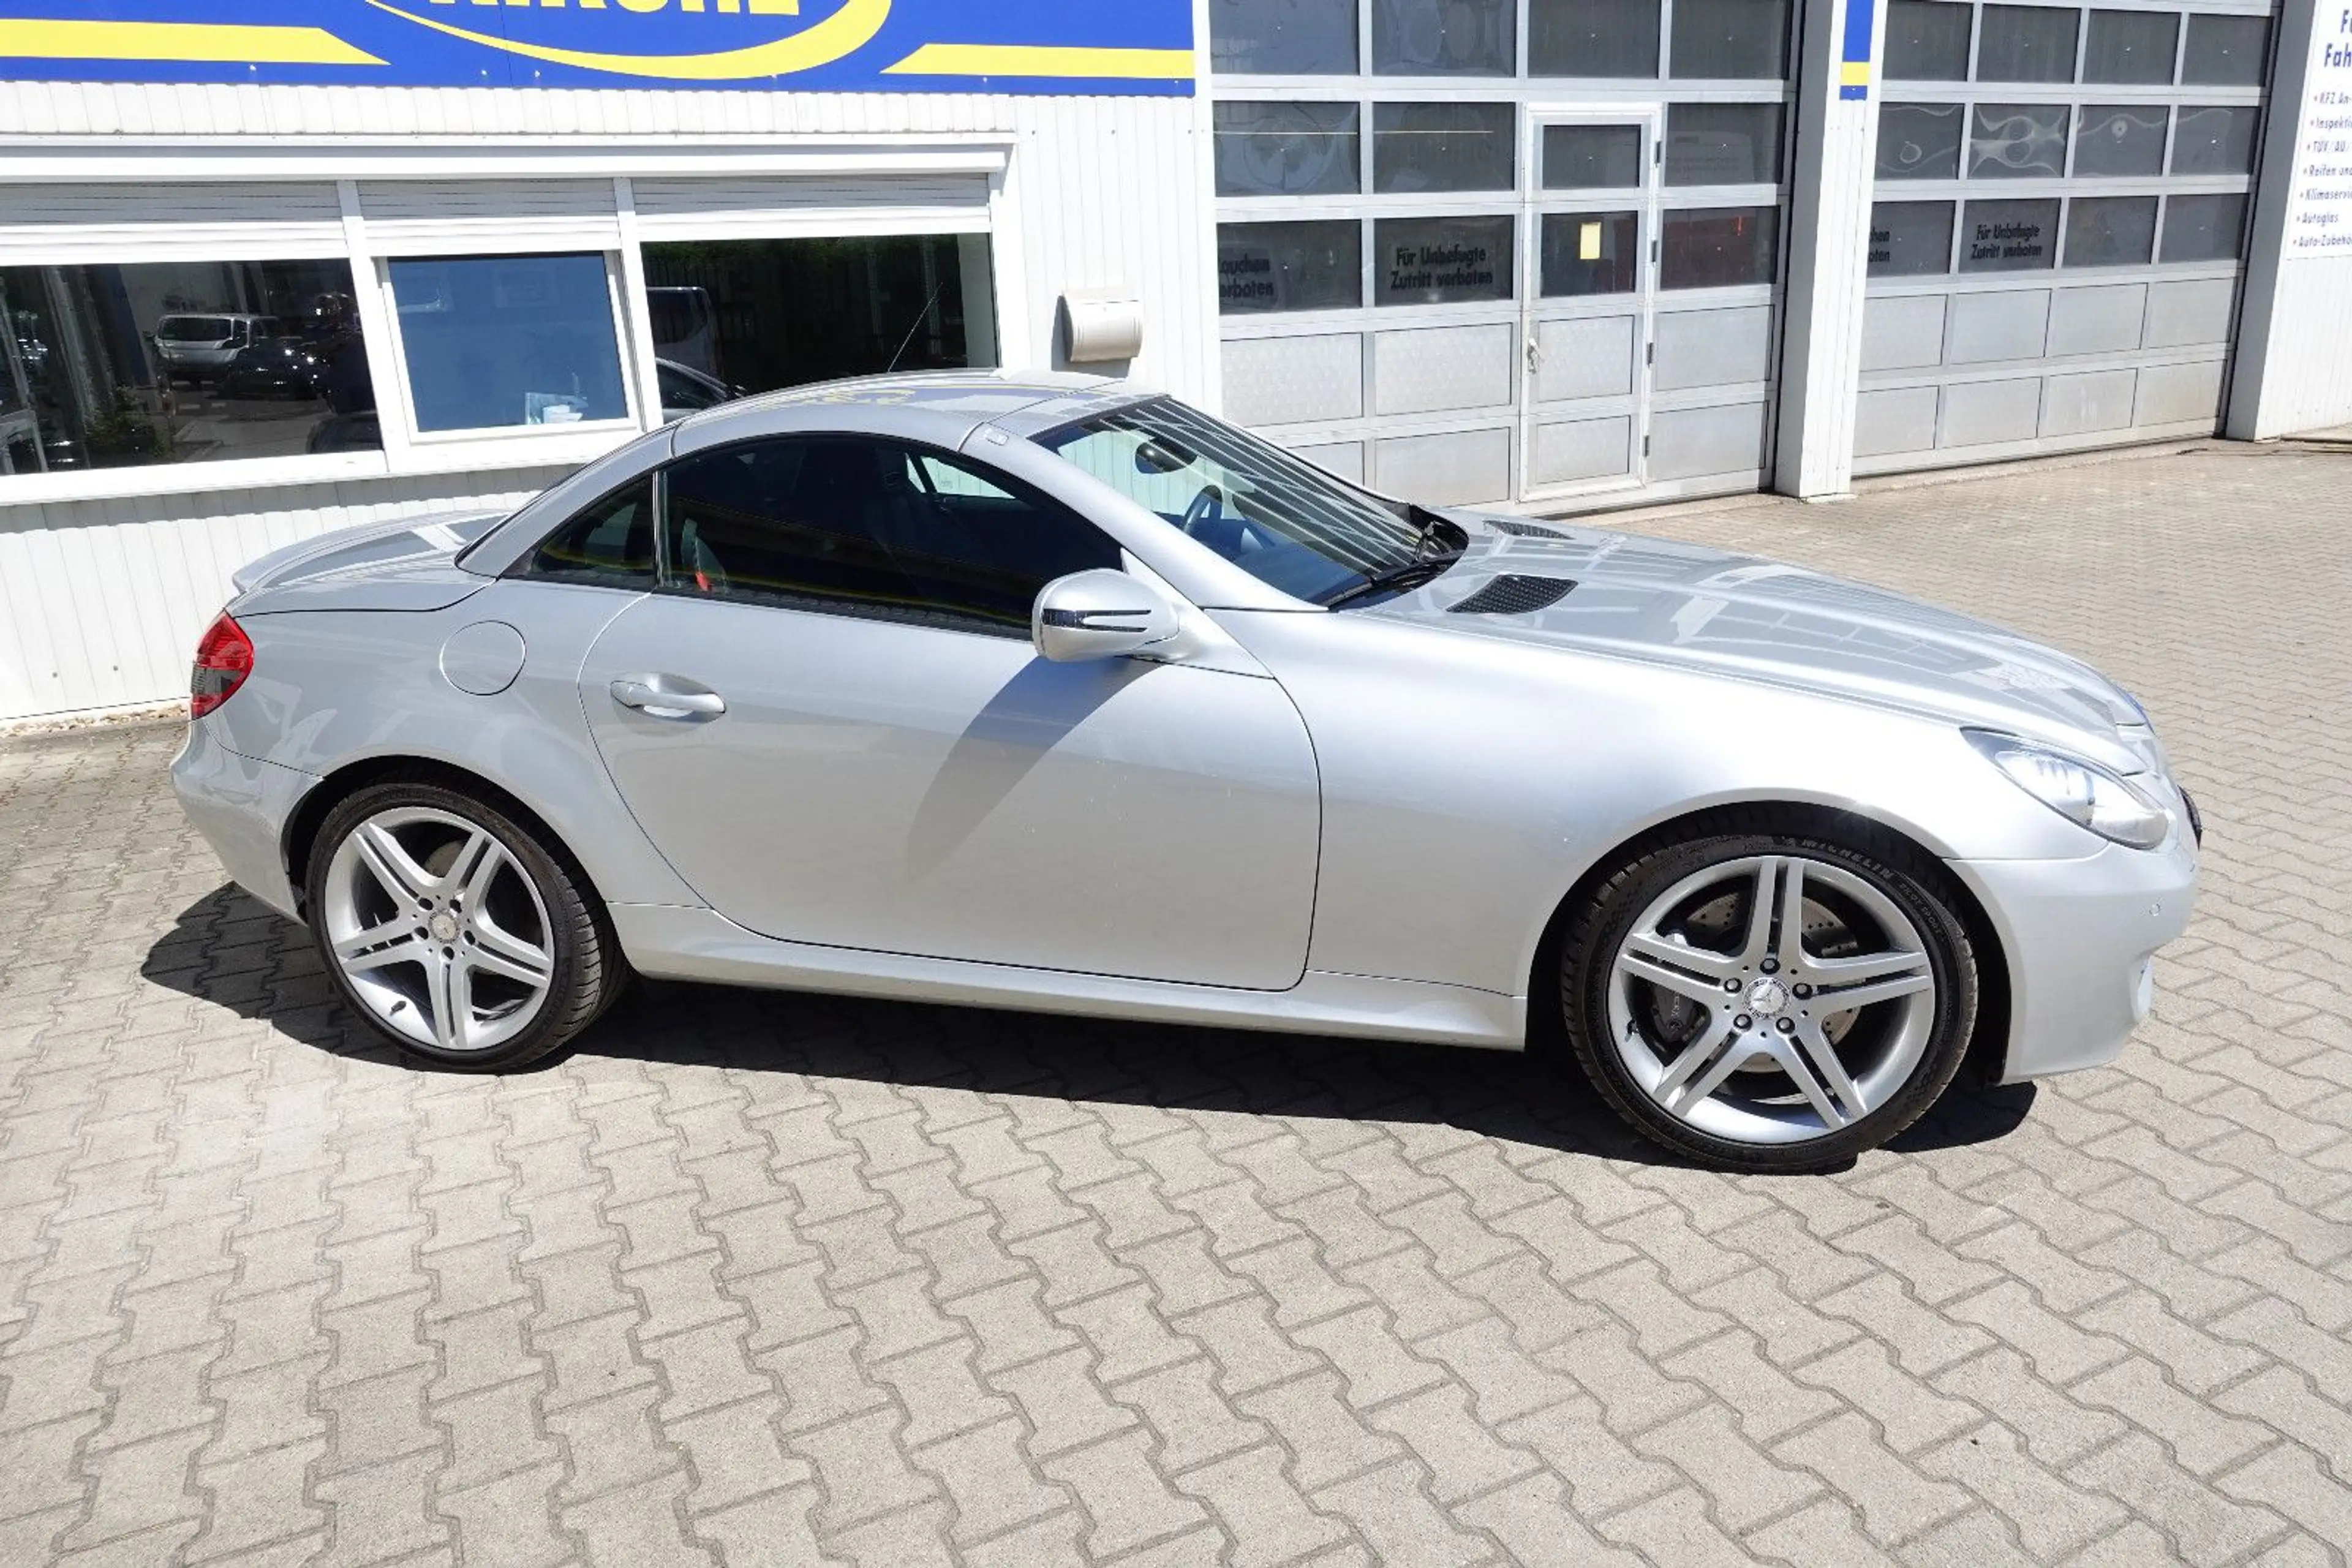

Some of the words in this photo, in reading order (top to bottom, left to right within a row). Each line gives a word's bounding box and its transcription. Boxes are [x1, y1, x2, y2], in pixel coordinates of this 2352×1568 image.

[2309, 165, 2336, 176] Reifen
[2302, 213, 2339, 227] Autoglas
[1396, 247, 1416, 266] Für
[1420, 244, 1486, 268] Unbefugte
[1391, 270, 1431, 290] Zutritt
[1436, 267, 1493, 287] verboten
[1801, 839, 1894, 879] MICHELIN
